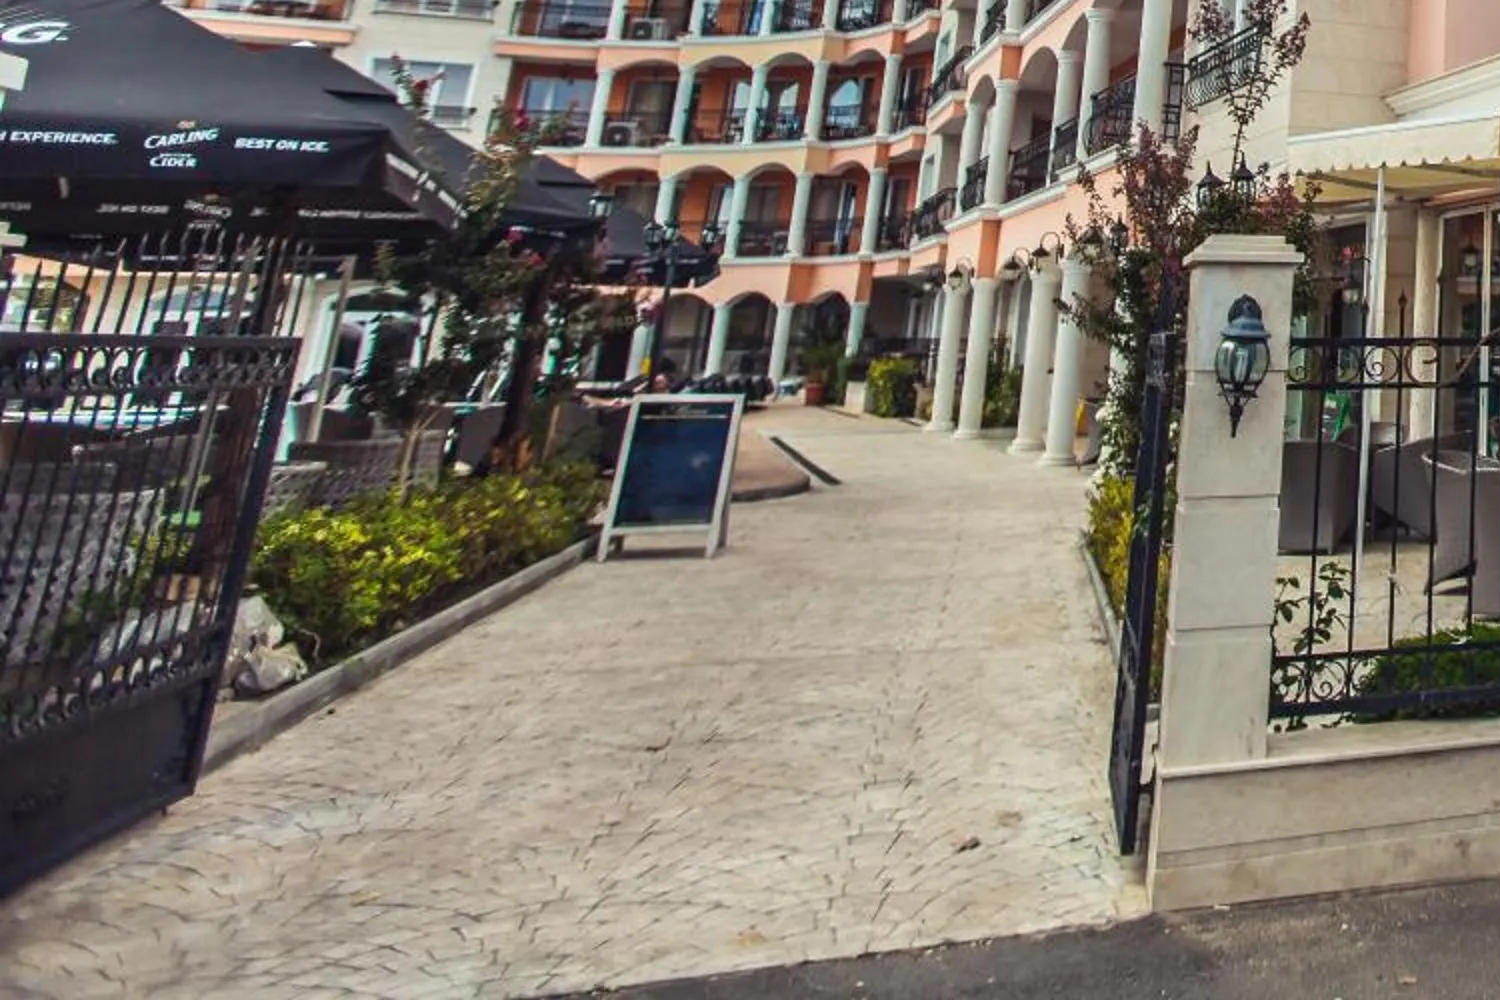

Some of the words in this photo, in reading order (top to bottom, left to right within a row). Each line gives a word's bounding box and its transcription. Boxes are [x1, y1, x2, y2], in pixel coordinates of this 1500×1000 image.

[144, 127, 221, 150] CARLING
[233, 136, 275, 151] BEST
[275, 139, 299, 152] ON
[149, 155, 198, 169] CIDER
